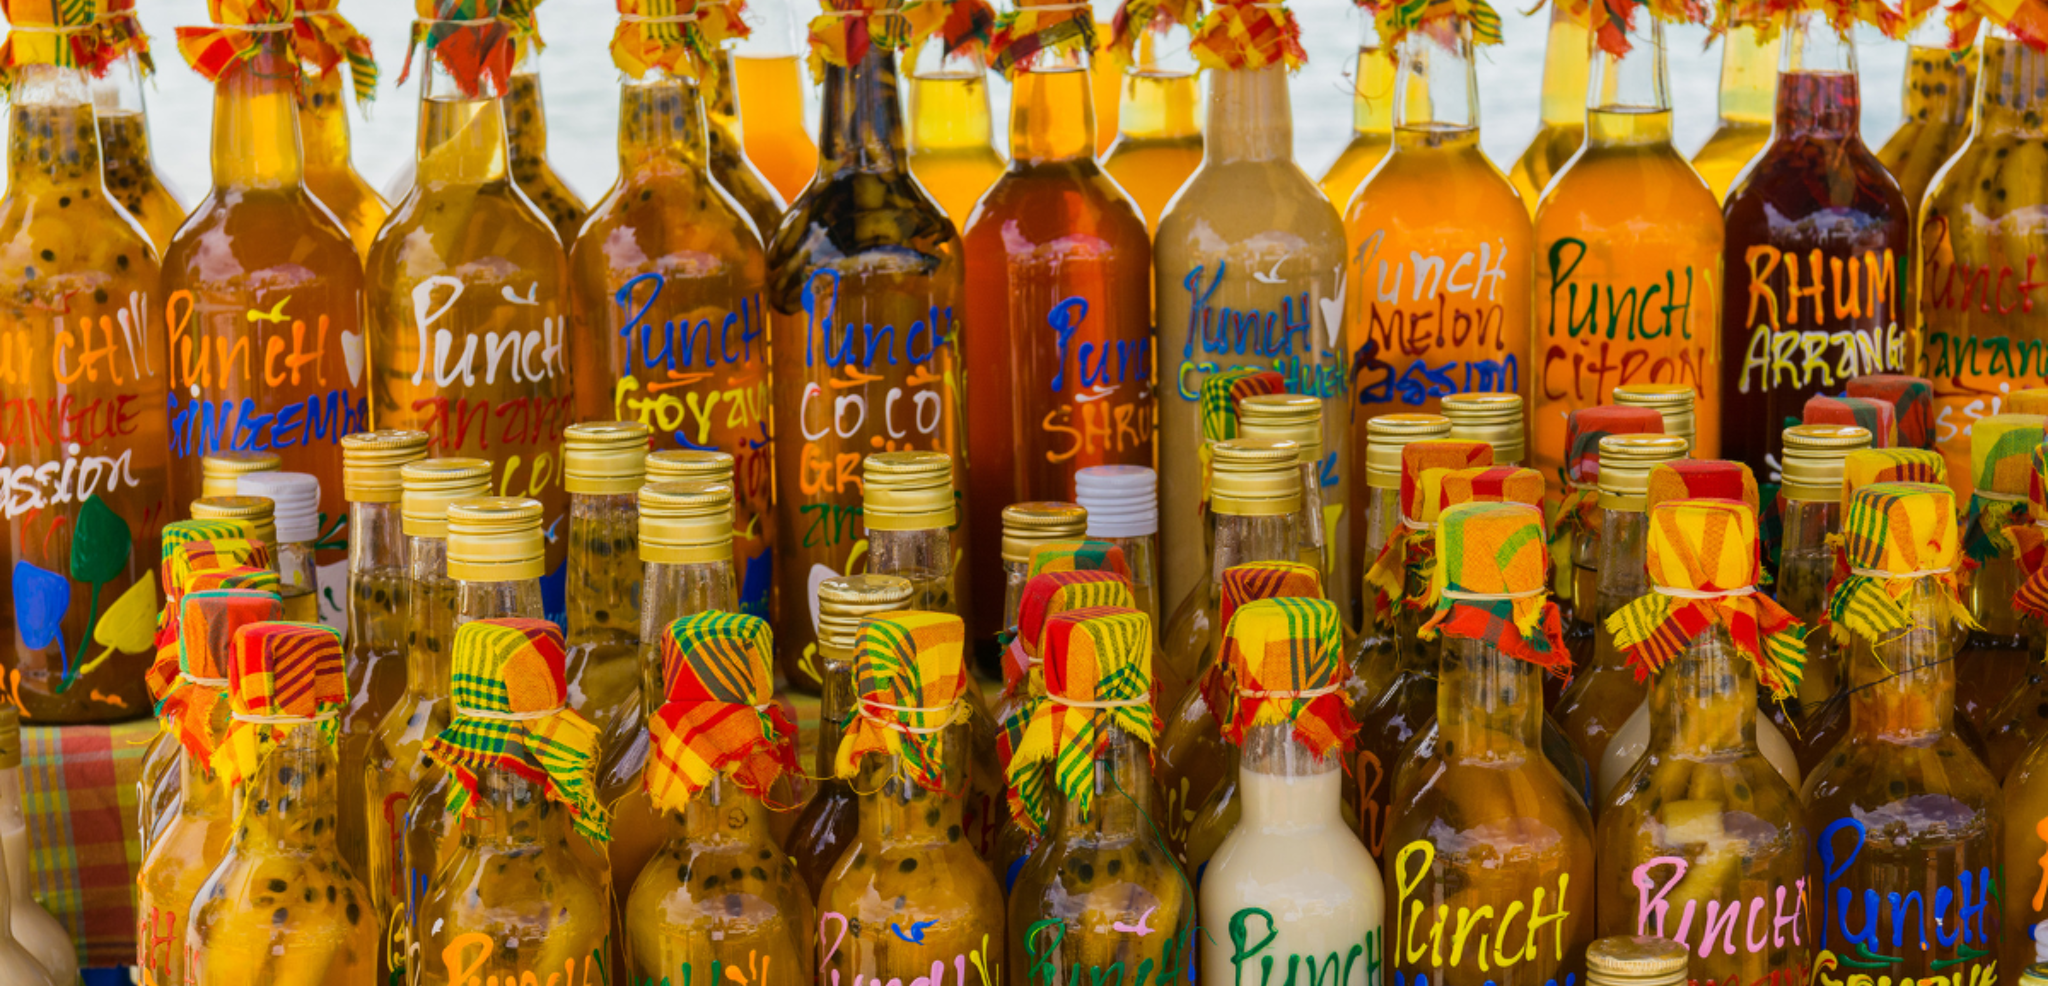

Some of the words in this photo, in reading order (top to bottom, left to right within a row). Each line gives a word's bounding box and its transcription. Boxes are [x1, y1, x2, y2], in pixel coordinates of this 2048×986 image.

[615, 272, 764, 377] PuncH
[801, 268, 952, 368] PuncH
[1183, 258, 1311, 359] PuncH
[1354, 228, 1508, 324] PuncH
[1548, 236, 1693, 341] PuncH
[1745, 244, 1896, 332] RHUM
[165, 289, 331, 390] PuncH
[411, 275, 565, 387] PuncH
[1394, 840, 1570, 973] PuncH
[1817, 817, 1990, 953] PuncH
